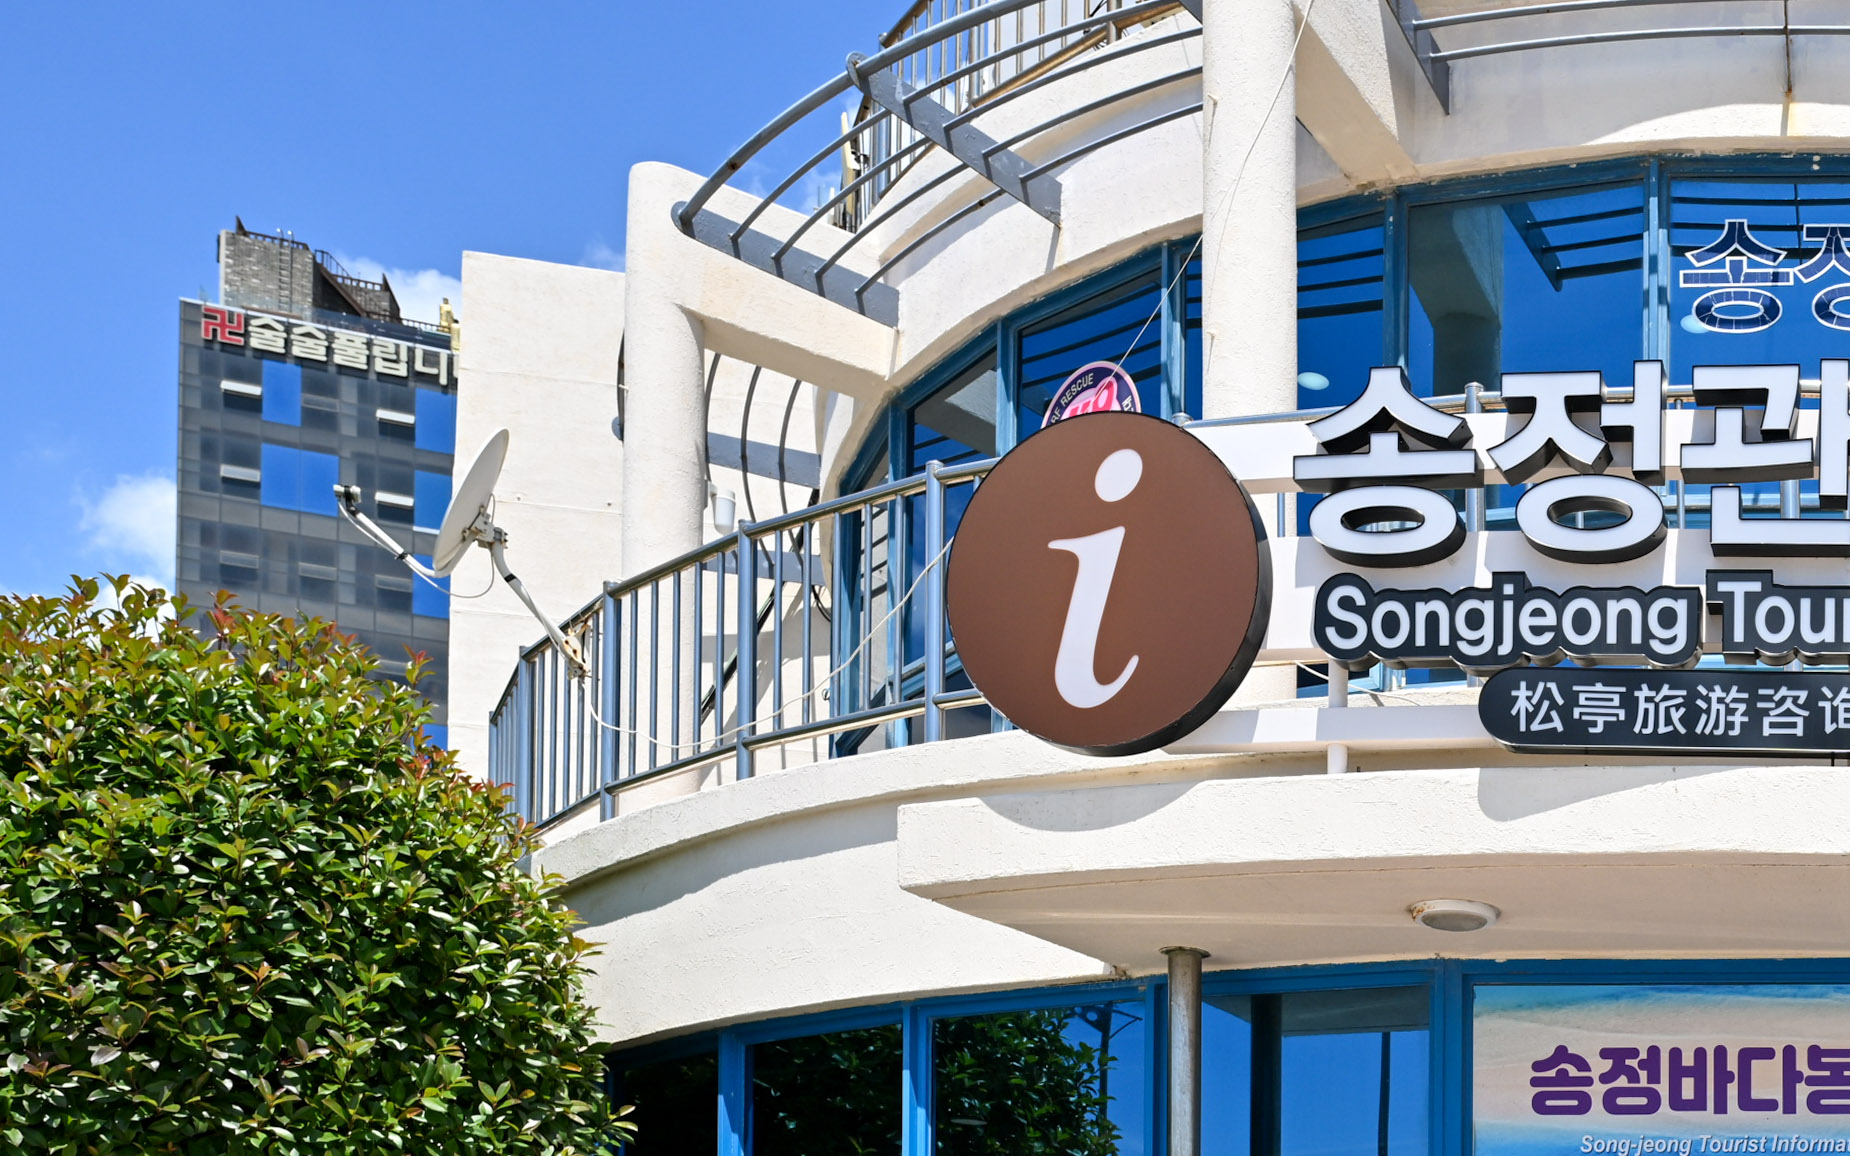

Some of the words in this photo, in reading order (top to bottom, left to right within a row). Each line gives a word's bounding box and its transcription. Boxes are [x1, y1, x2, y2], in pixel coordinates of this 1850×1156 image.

[249, 316, 459, 386] 술술풀립니
[1060, 372, 1094, 407] RESCUE
[1324, 580, 1688, 661] Songjeong
[1699, 1134, 1767, 1154] Tourist
